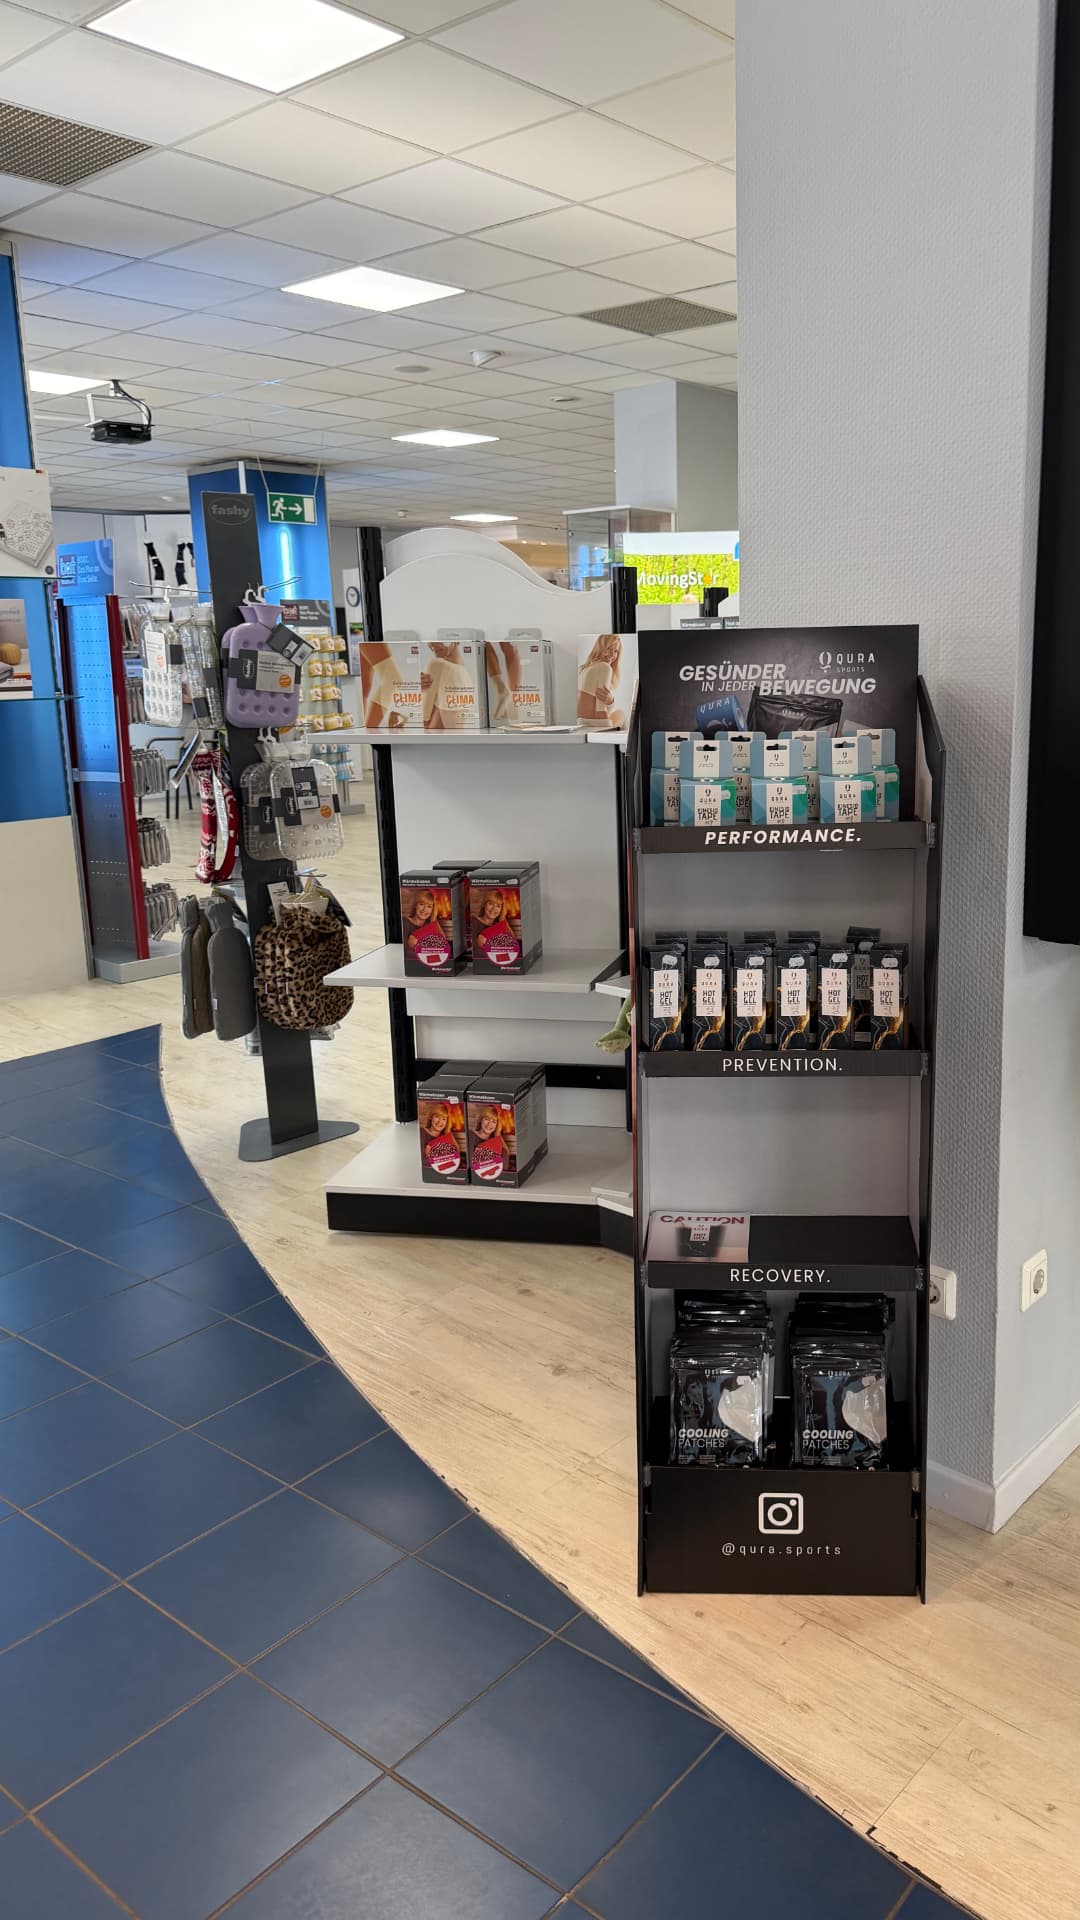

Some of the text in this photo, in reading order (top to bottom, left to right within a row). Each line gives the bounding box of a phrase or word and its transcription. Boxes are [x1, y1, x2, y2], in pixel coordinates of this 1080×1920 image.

[211, 504, 250, 518] fashy
[836, 652, 875, 664] QURA
[679, 660, 786, 681] GESÜNDER
[701, 678, 877, 696] IN JEDER BEWEGUNG
[446, 694, 475, 704] CLIMA
[512, 693, 540, 703] CLIMA
[700, 697, 730, 714] QURA
[698, 812, 717, 820] TAPE
[838, 808, 858, 816] TAPE
[705, 828, 861, 845] PERFORMANCE.
[723, 1057, 843, 1072] PREVENTION.
[730, 1268, 831, 1283] RECOVERY.
[678, 1428, 729, 1438] COOLING
[802, 1429, 854, 1439] COOLING
[678, 1438, 725, 1448] PATCHES
[802, 1440, 849, 1449] PATCHES
[722, 1542, 842, 1556] @qura.sports
